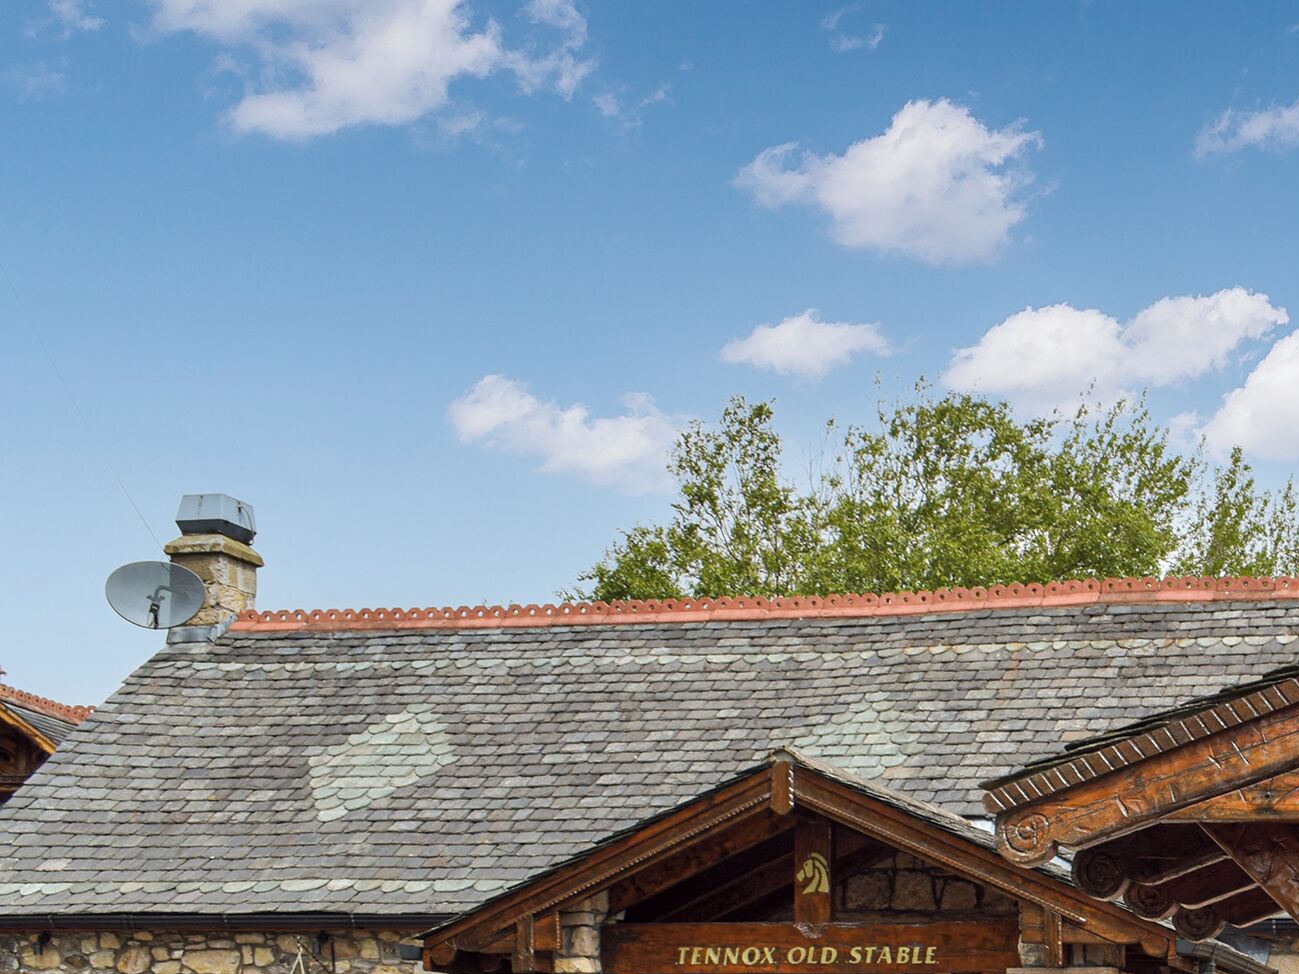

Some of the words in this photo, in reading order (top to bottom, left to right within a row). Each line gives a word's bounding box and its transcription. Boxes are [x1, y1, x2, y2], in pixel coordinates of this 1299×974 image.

[677, 946, 776, 966] TENNOX
[787, 946, 837, 965] OLD
[849, 946, 937, 965] STABLE
